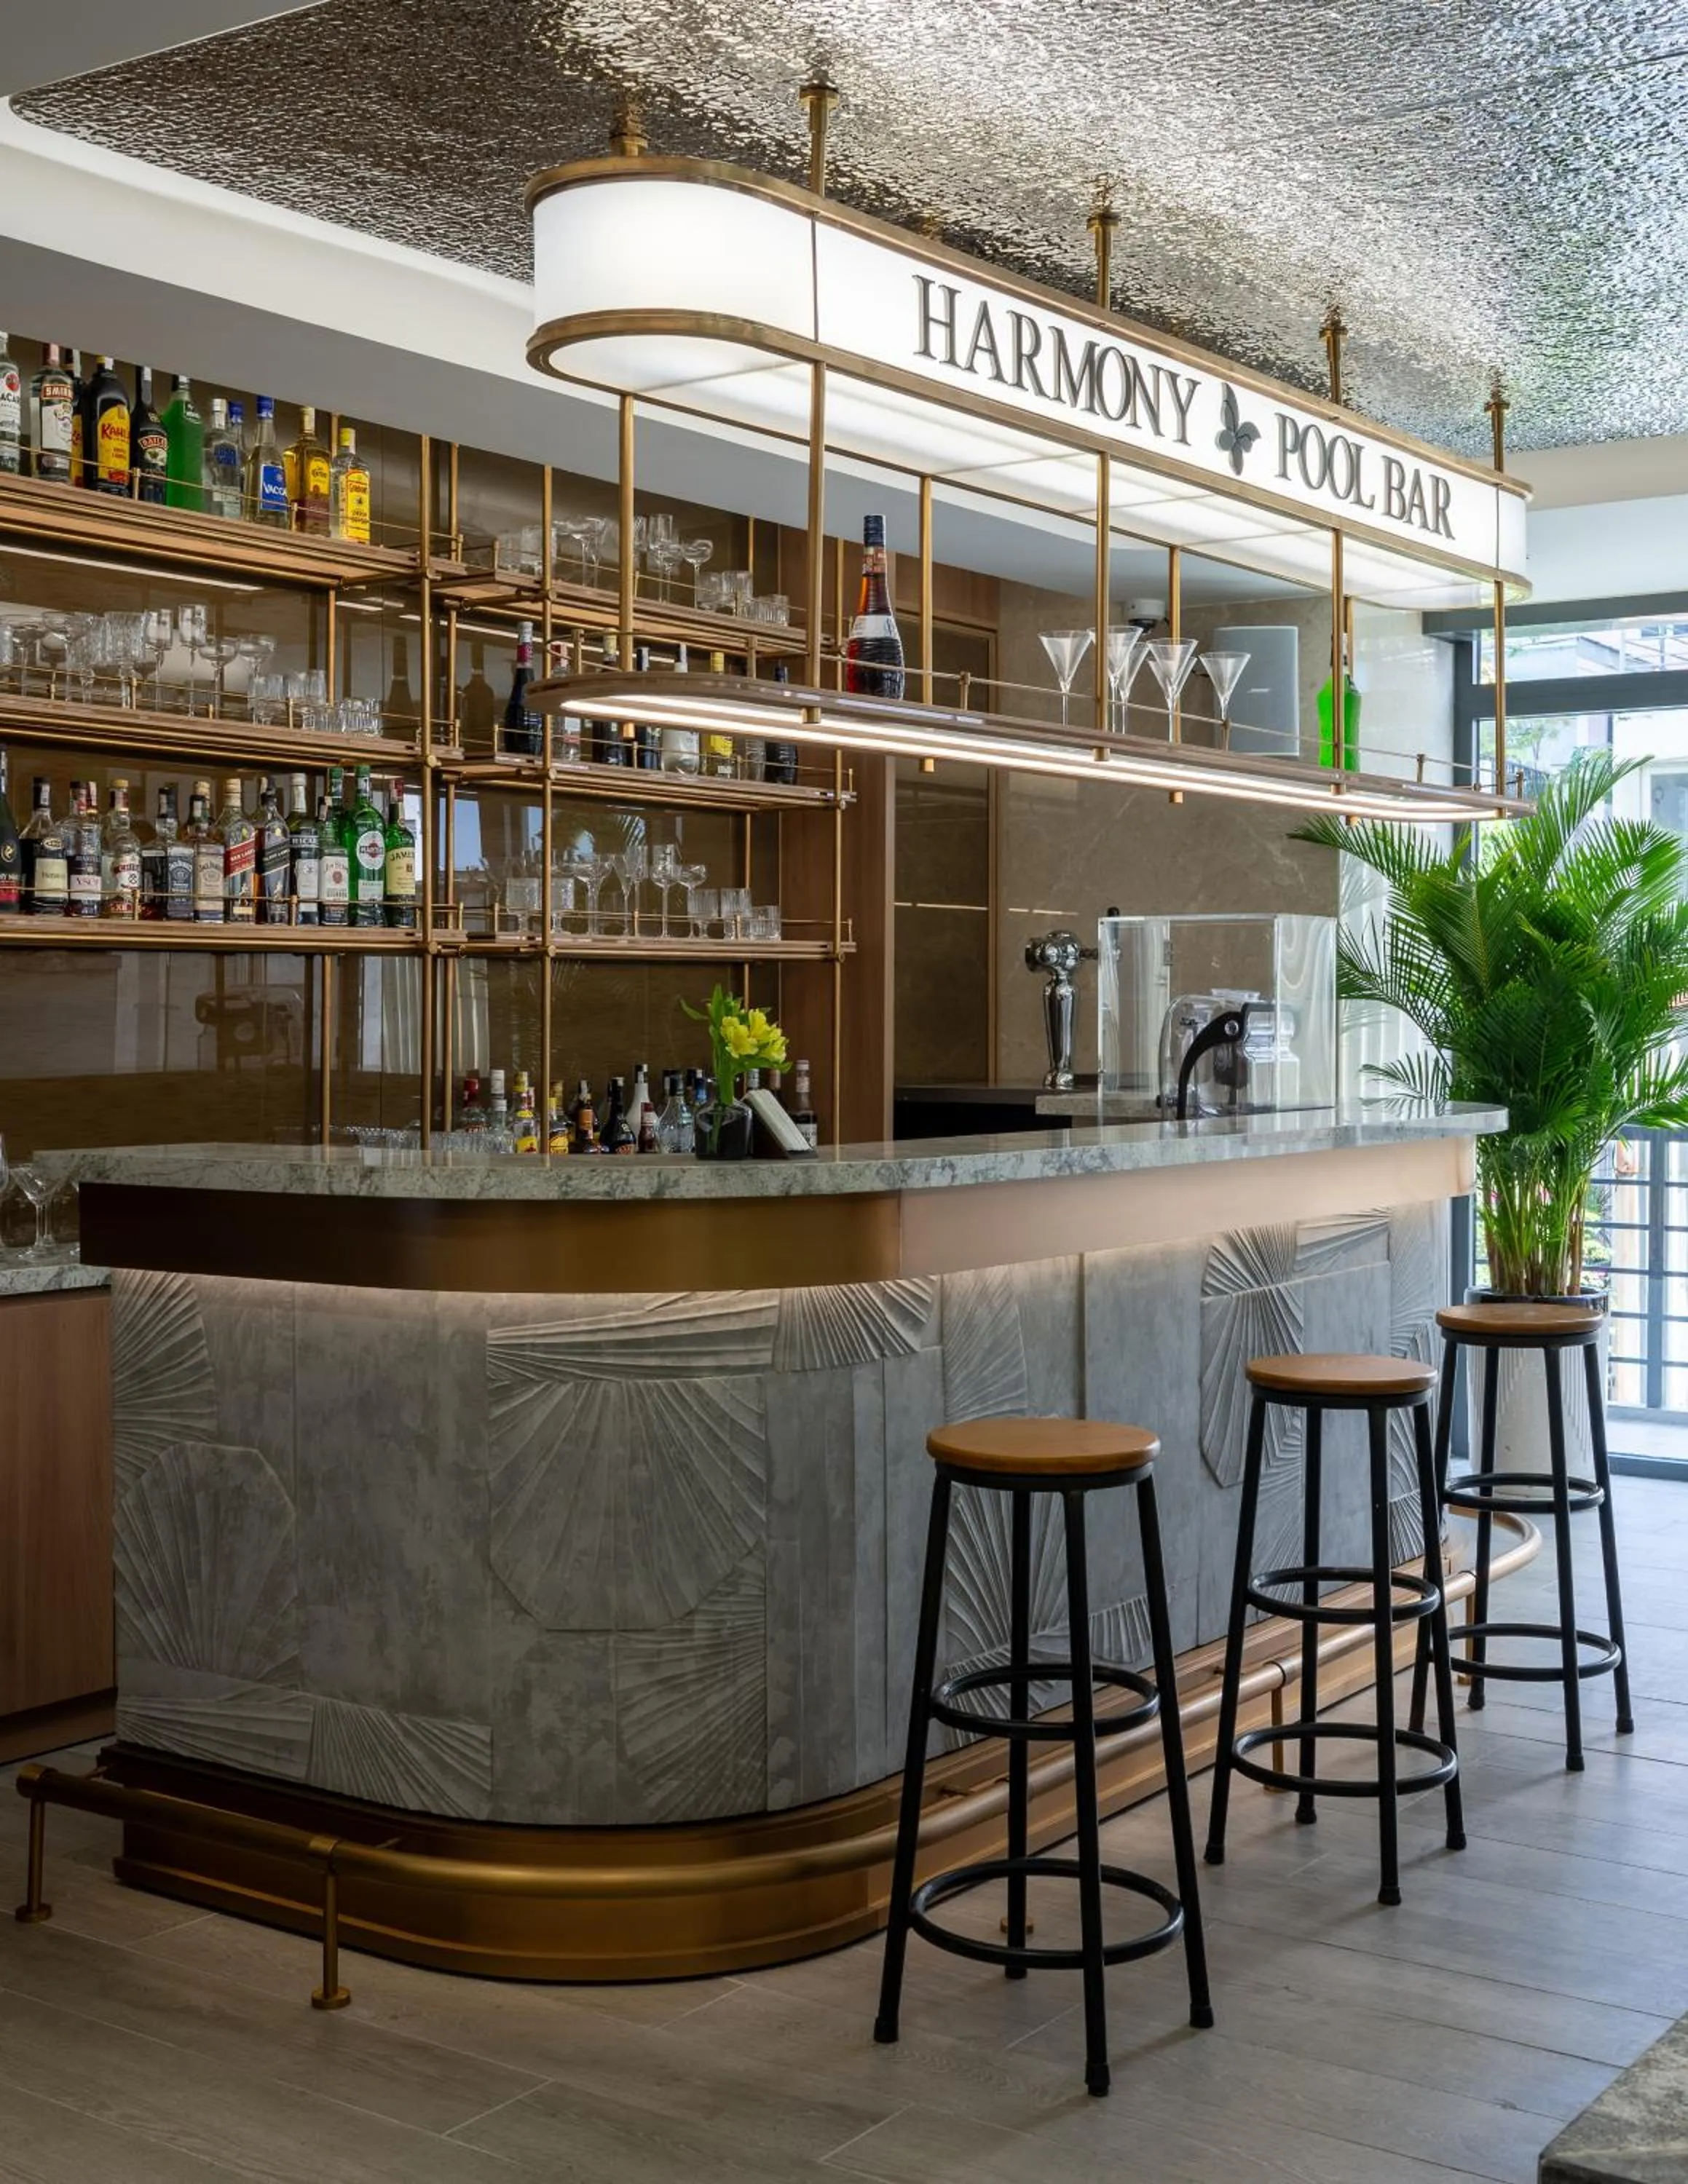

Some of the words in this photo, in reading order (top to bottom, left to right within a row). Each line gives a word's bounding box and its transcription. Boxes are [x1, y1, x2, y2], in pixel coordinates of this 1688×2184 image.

[912, 274, 1202, 446] HARMONY
[1274, 412, 1375, 509] POOL
[1381, 455, 1456, 540] BAR
